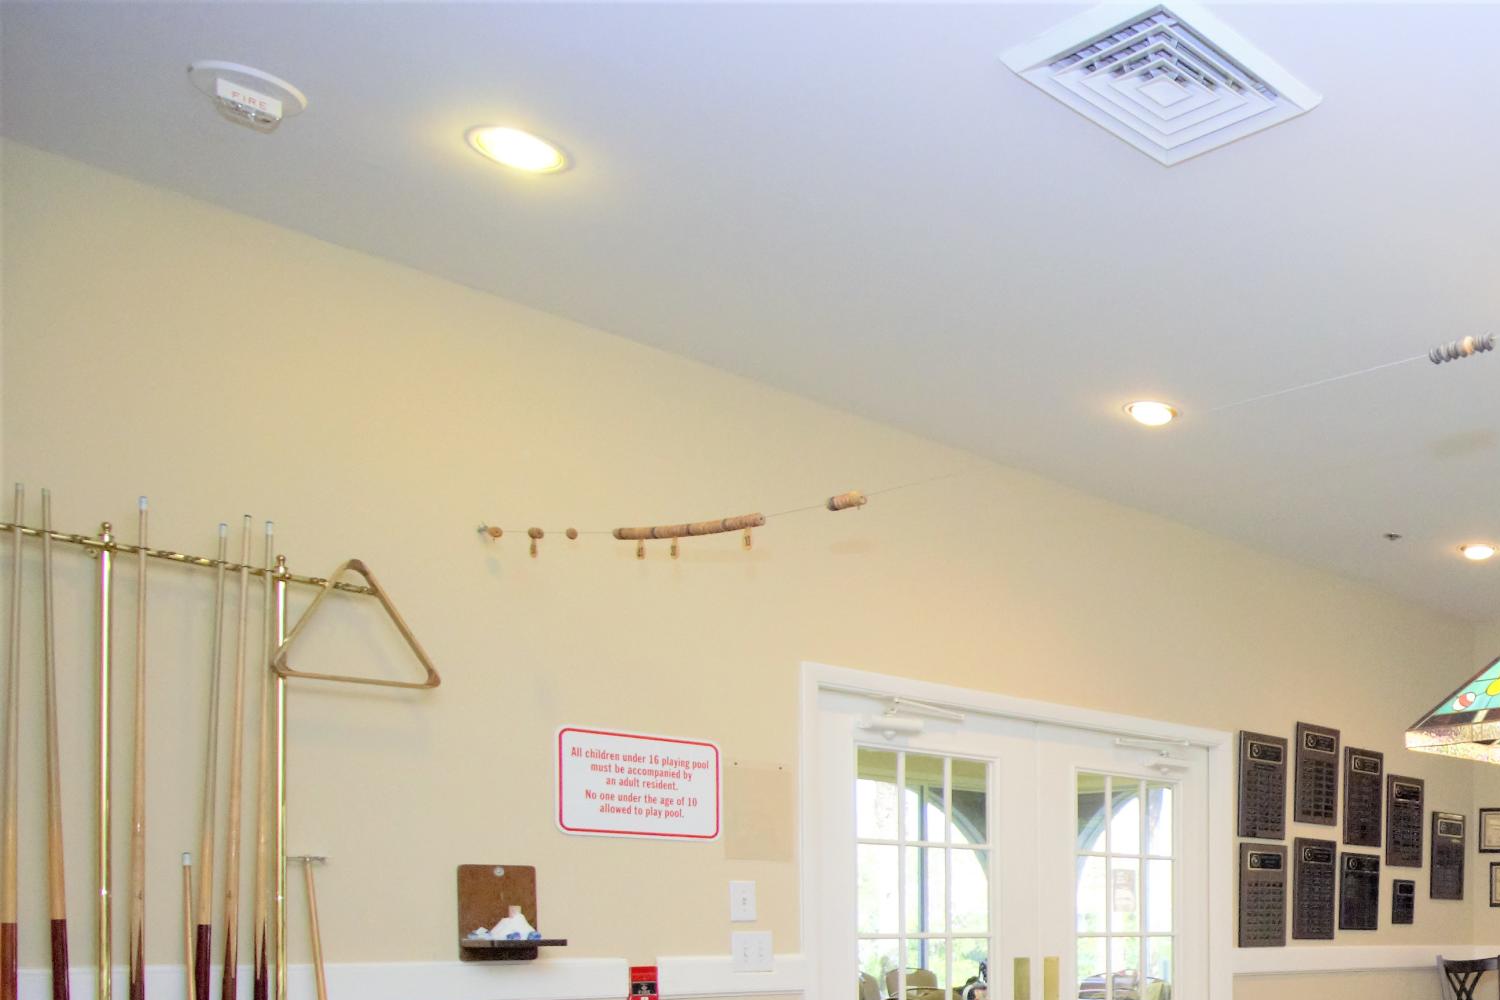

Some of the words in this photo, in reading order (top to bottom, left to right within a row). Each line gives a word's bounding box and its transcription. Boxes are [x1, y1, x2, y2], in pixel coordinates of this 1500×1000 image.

[571, 746, 582, 757] All
[585, 748, 620, 760] children
[622, 753, 645, 763] under
[649, 754, 659, 765] 16
[661, 756, 689, 770] playing
[692, 760, 709, 770] pool
[591, 763, 612, 773] must
[615, 763, 625, 774] be
[627, 767, 681, 779] accompanied
[683, 770, 692, 781] by
[606, 777, 616, 785] an
[619, 777, 640, 788] adult
[642, 780, 679, 791] resident.
[585, 789, 597, 800] No
[599, 792, 615, 801] one
[617, 793, 641, 803] under
[644, 794, 657, 805] the
[660, 797, 674, 807] age
[676, 796, 685, 806] of
[599, 803, 632, 815] allowed
[634, 805, 643, 815] to
[645, 807, 662, 819] play
[664, 808, 684, 819] pool.
